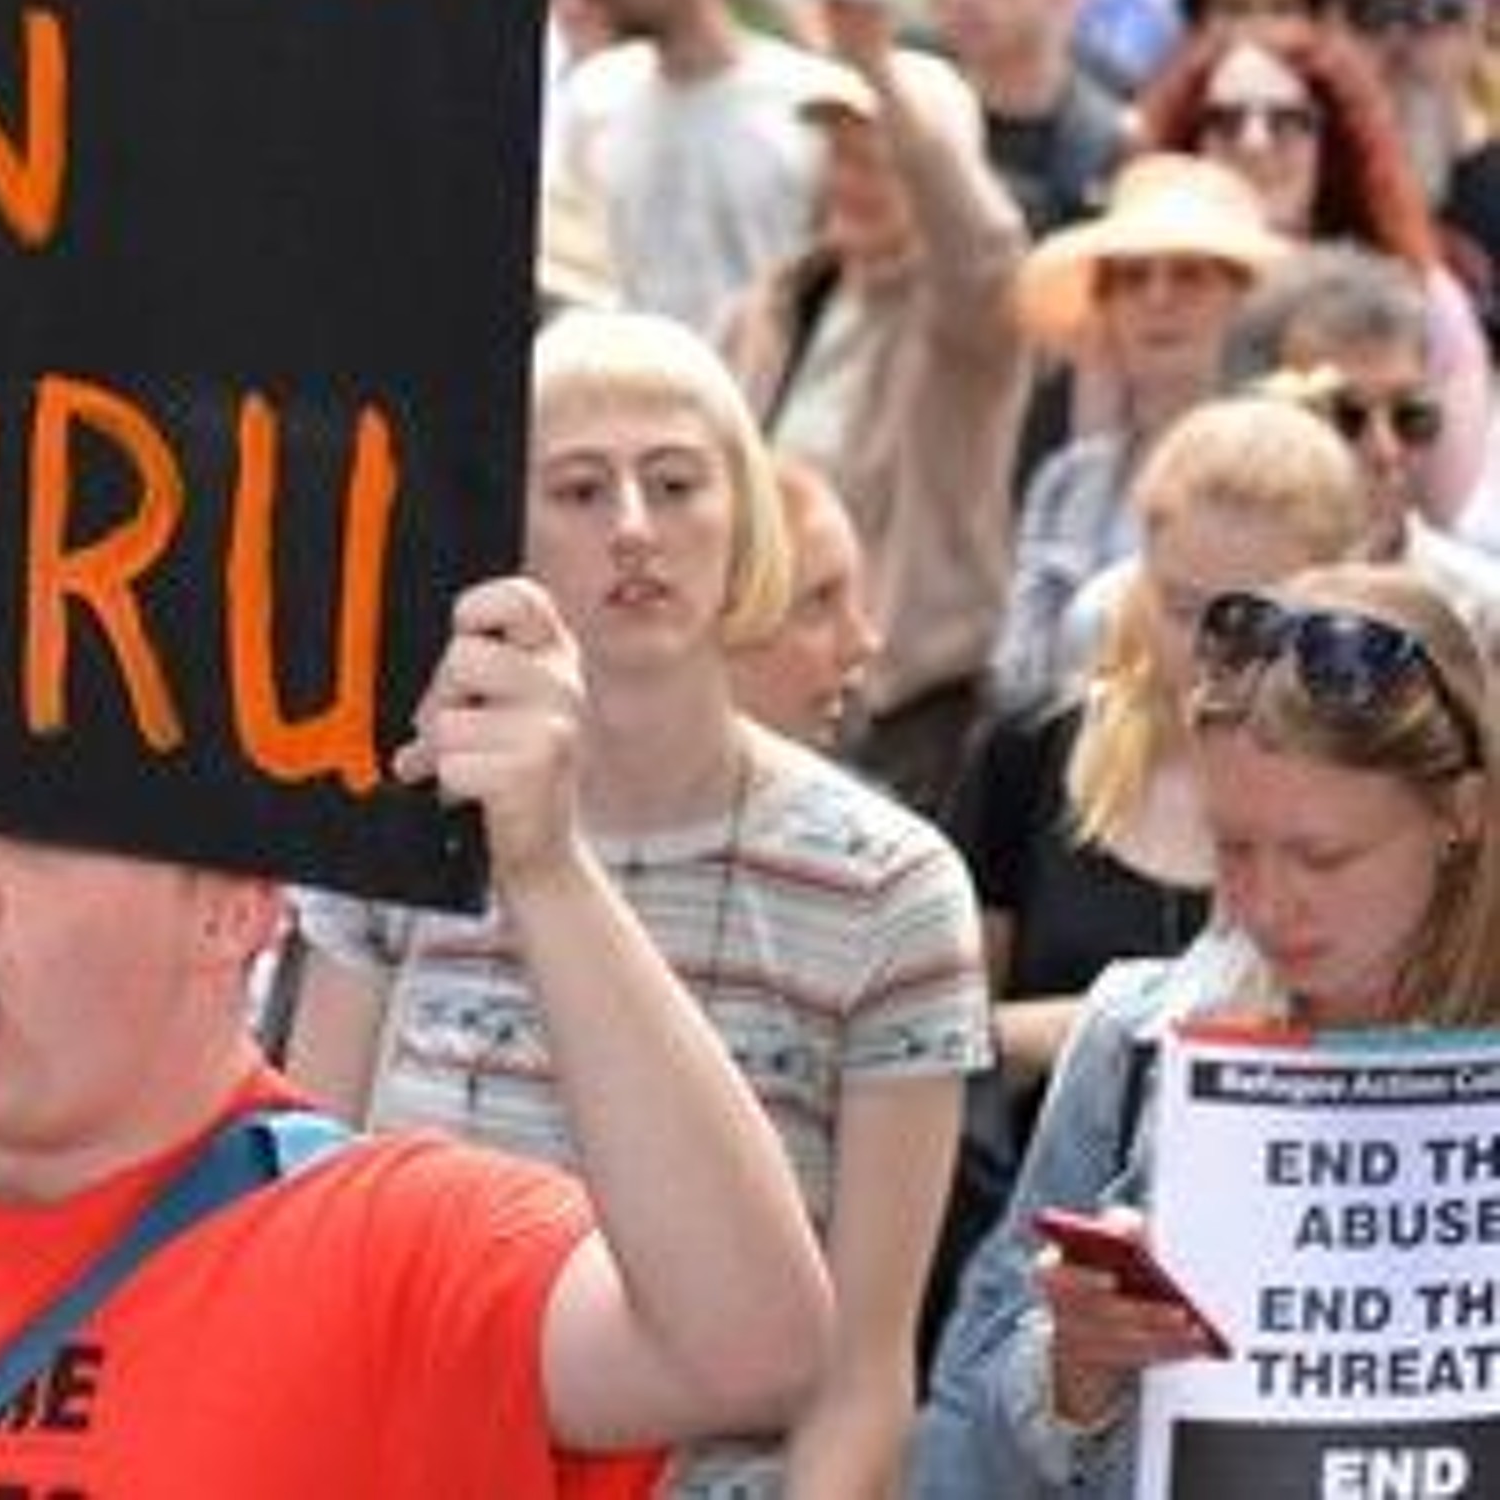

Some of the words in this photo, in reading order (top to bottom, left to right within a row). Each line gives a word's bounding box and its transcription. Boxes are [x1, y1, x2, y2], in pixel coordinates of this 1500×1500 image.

[1264, 1138, 1399, 1188] END
[1294, 1198, 1500, 1252] ABUSE
[1258, 1285, 1392, 1333] END
[1322, 1447, 1471, 1500] END
